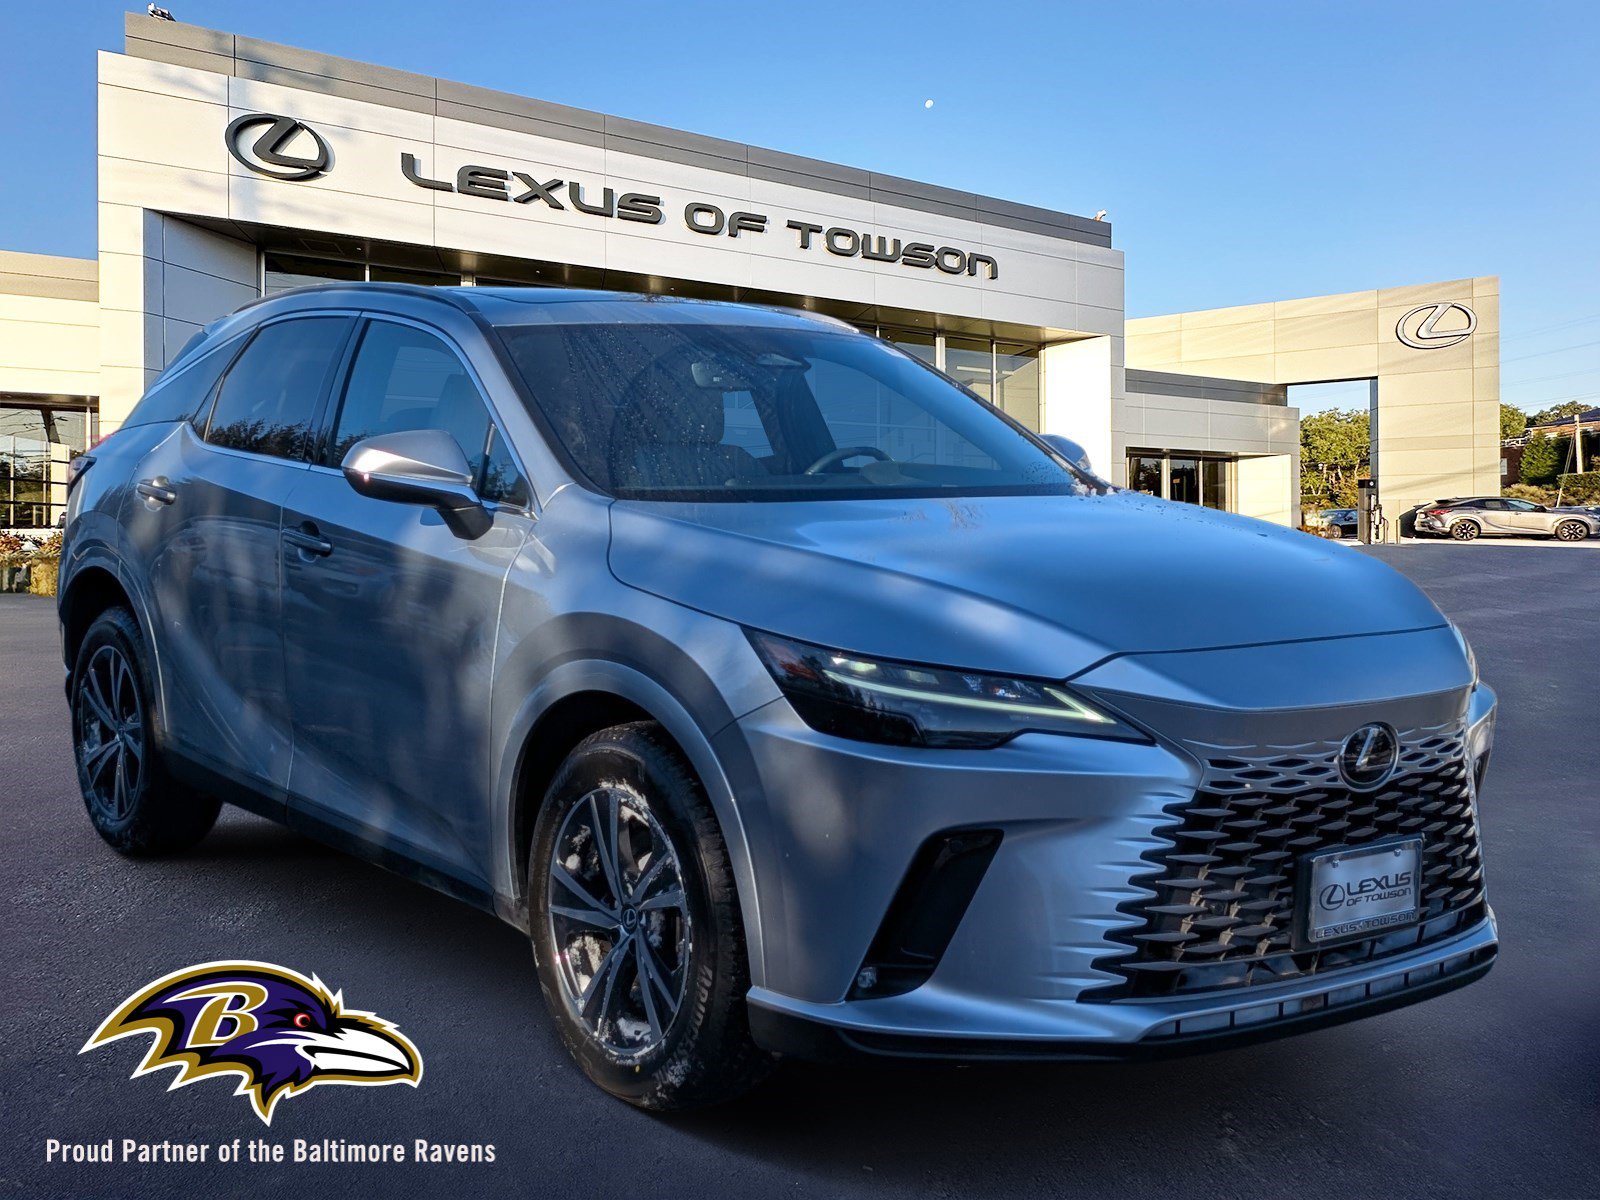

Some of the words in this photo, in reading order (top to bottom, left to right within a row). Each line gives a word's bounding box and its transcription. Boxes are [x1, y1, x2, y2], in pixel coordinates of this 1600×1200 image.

[400, 152, 663, 225] LEXUS
[684, 201, 767, 238] OF
[787, 219, 999, 280] TOWSON
[1346, 871, 1412, 896] LEXUS
[1346, 896, 1364, 907] OF
[1364, 887, 1412, 904] TOWSON
[1315, 922, 1357, 939] LEXUS
[1364, 911, 1416, 929] TOWSON
